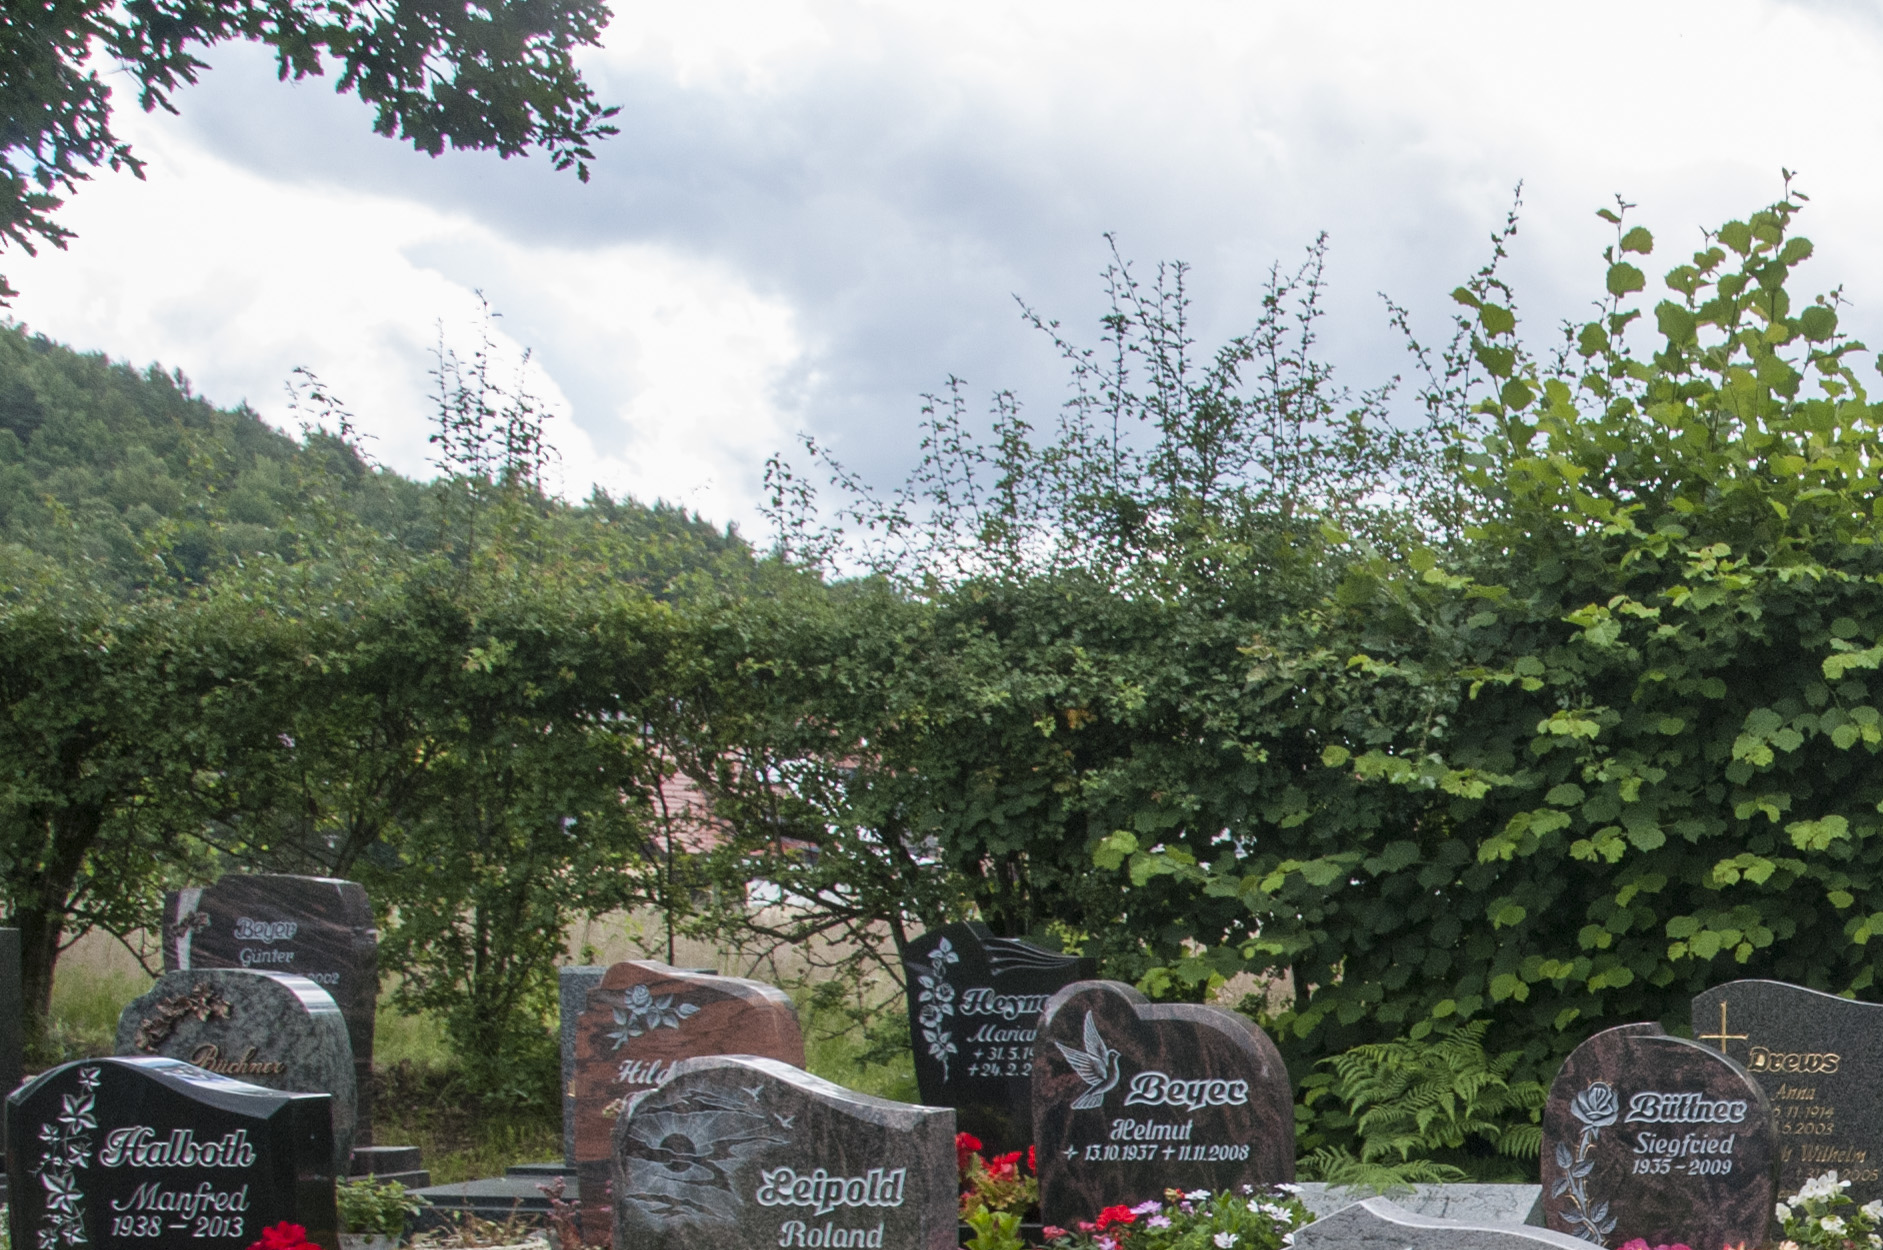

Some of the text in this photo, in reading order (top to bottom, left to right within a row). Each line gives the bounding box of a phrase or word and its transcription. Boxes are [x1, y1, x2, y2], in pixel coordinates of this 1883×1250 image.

[233, 916, 298, 944] Beyer
[240, 947, 294, 967] Günter
[960, 987, 1051, 1020] Heym
[618, 1059, 677, 1084] Hild
[1747, 1046, 1841, 1074] Drews
[1124, 1071, 1249, 1112] Beyer
[1771, 1083, 1816, 1101] Anna
[1624, 1091, 1748, 1124] Büttner
[1110, 1118, 1194, 1141] Helmut
[100, 1125, 257, 1168] Halboth
[1632, 1131, 1736, 1158] Siegfried
[1631, 1158, 1672, 1175] 1935
[1687, 1158, 1733, 1176] 2009
[110, 1181, 251, 1220] Manfred
[757, 1166, 907, 1217] Leipold
[111, 1215, 162, 1238] 1938
[192, 1215, 245, 1238] 2013
[778, 1220, 885, 1249] Roland
